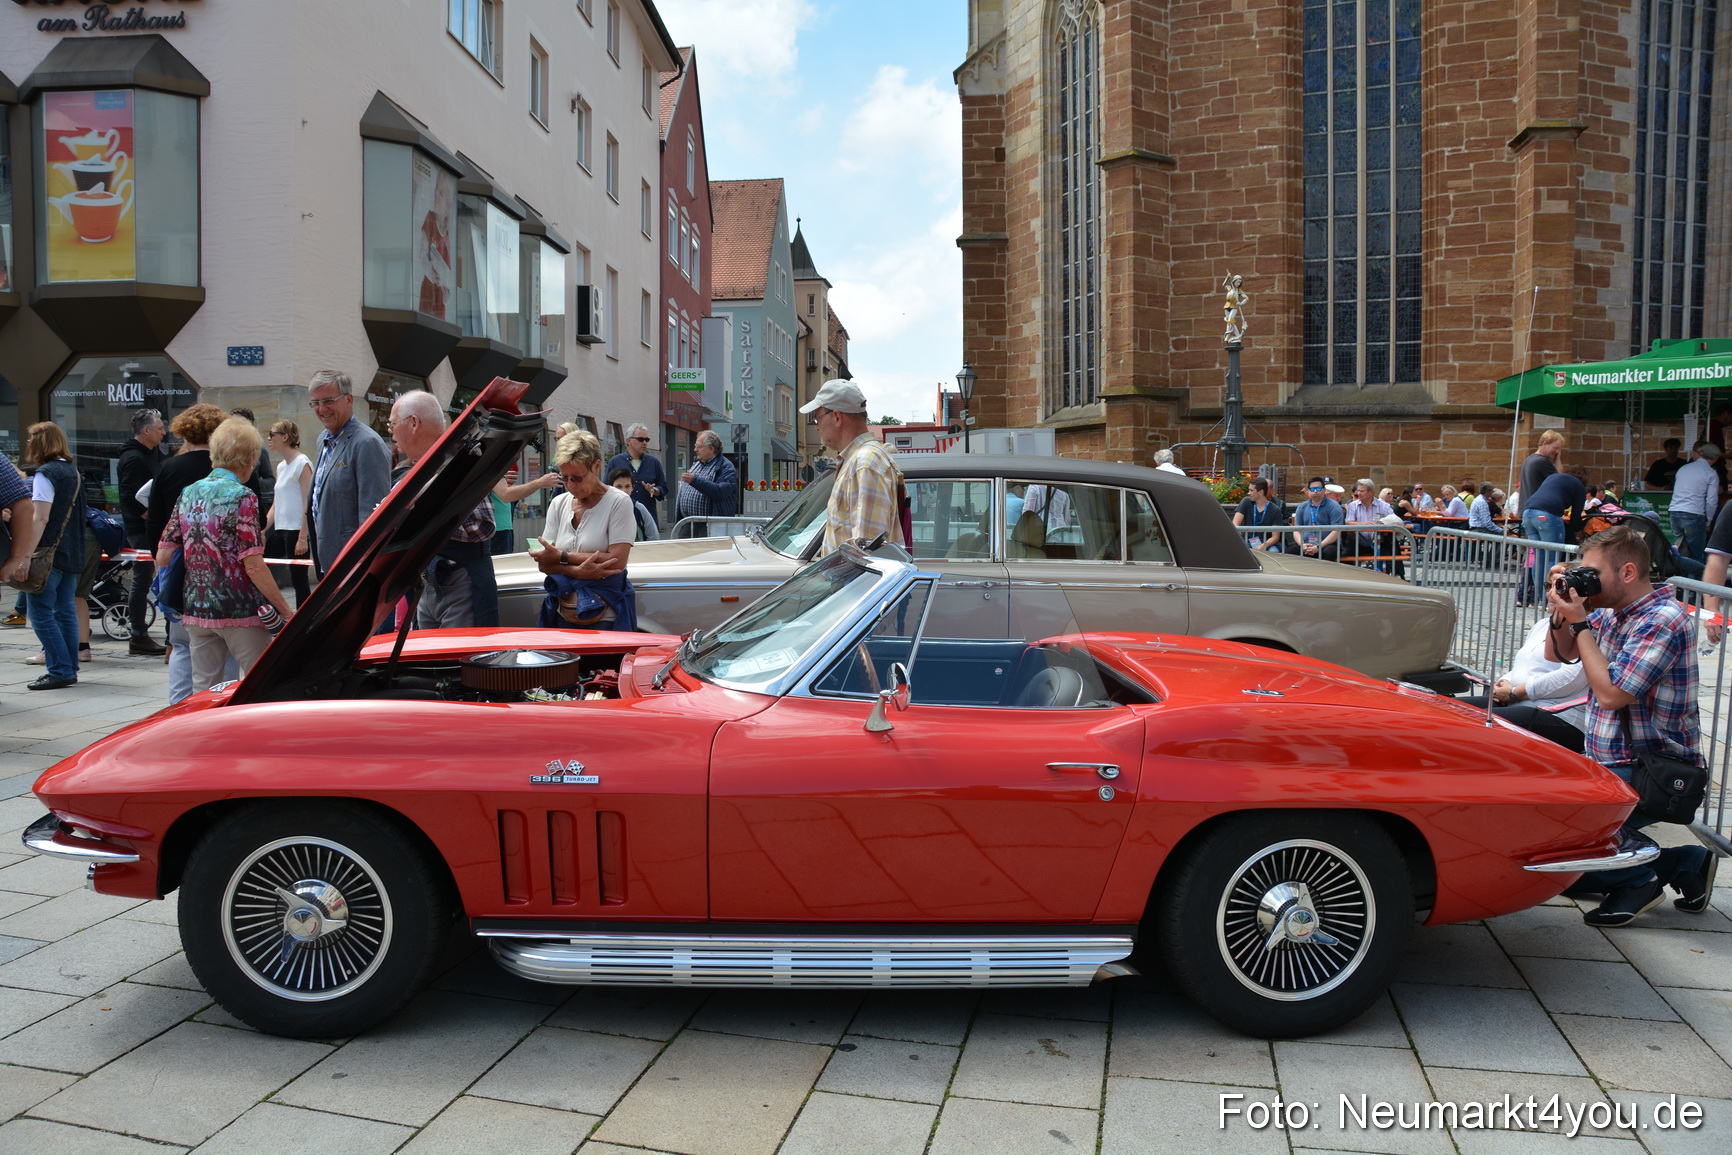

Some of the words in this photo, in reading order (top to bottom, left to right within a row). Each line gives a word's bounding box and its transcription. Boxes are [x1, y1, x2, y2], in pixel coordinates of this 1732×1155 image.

[37, 18, 77, 32] am
[82, 4, 186, 31] Rathaus
[740, 319, 756, 413] satzke
[1571, 370, 1653, 386] Neumarkter
[1657, 363, 1732, 381] Lammsbr
[108, 383, 144, 401] RACKL
